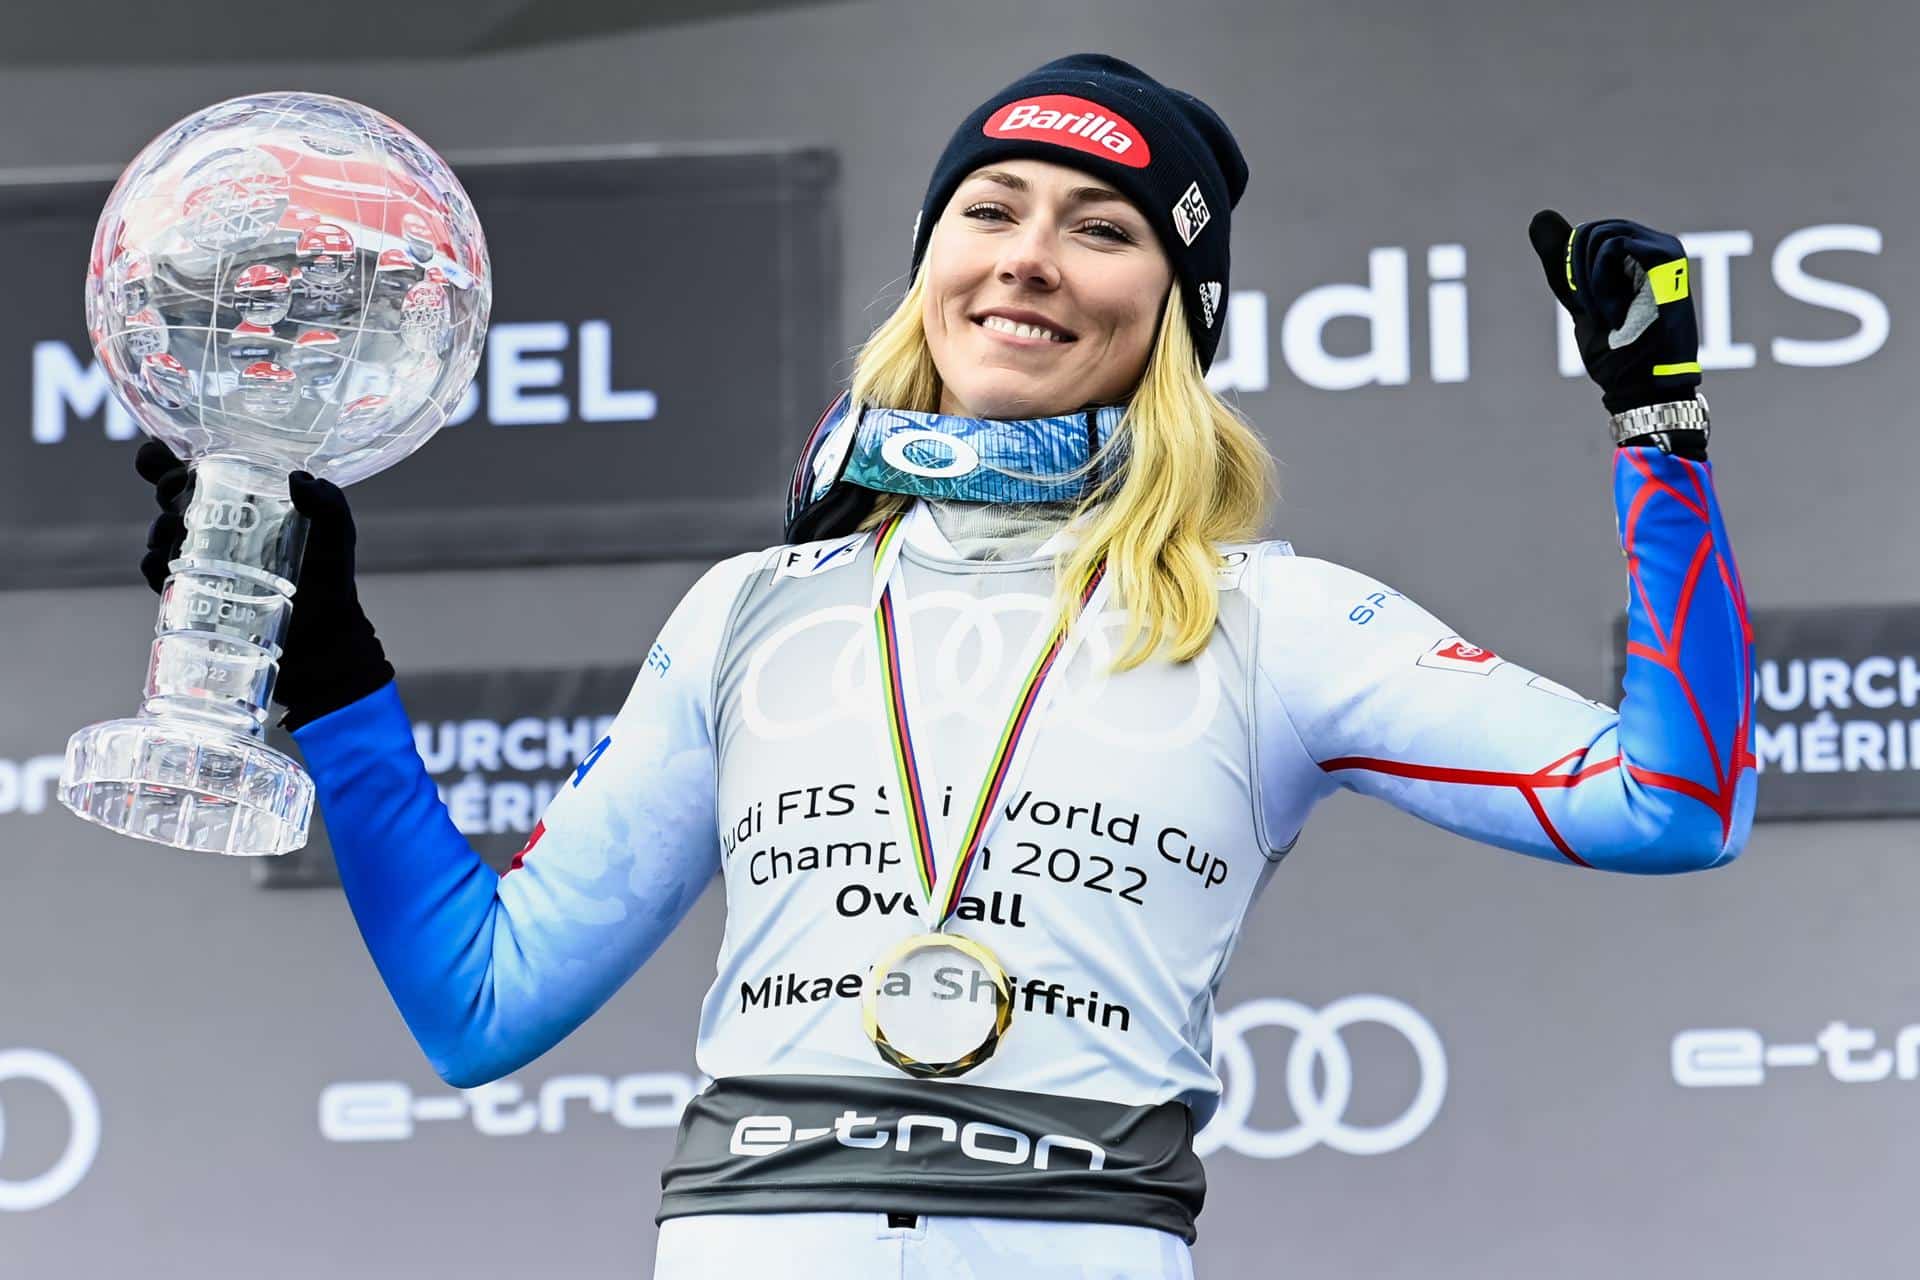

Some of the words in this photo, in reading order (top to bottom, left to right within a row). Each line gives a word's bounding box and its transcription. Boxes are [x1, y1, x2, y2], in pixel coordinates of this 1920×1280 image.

[998, 104, 1134, 155] Barilla
[1205, 243, 1470, 393] udi
[1557, 223, 1891, 378] IS
[1754, 655, 1920, 712] URC
[722, 801, 762, 860] udi
[777, 783, 856, 825] FIS
[1156, 826, 1228, 889] Cup
[835, 883, 1027, 928] Oveall
[1010, 841, 1148, 906] 2022
[739, 964, 912, 1014] Mikaea
[931, 966, 1132, 1032] Shiffrin
[317, 1071, 706, 1142] e-tro
[729, 1109, 1106, 1171] e-tron
